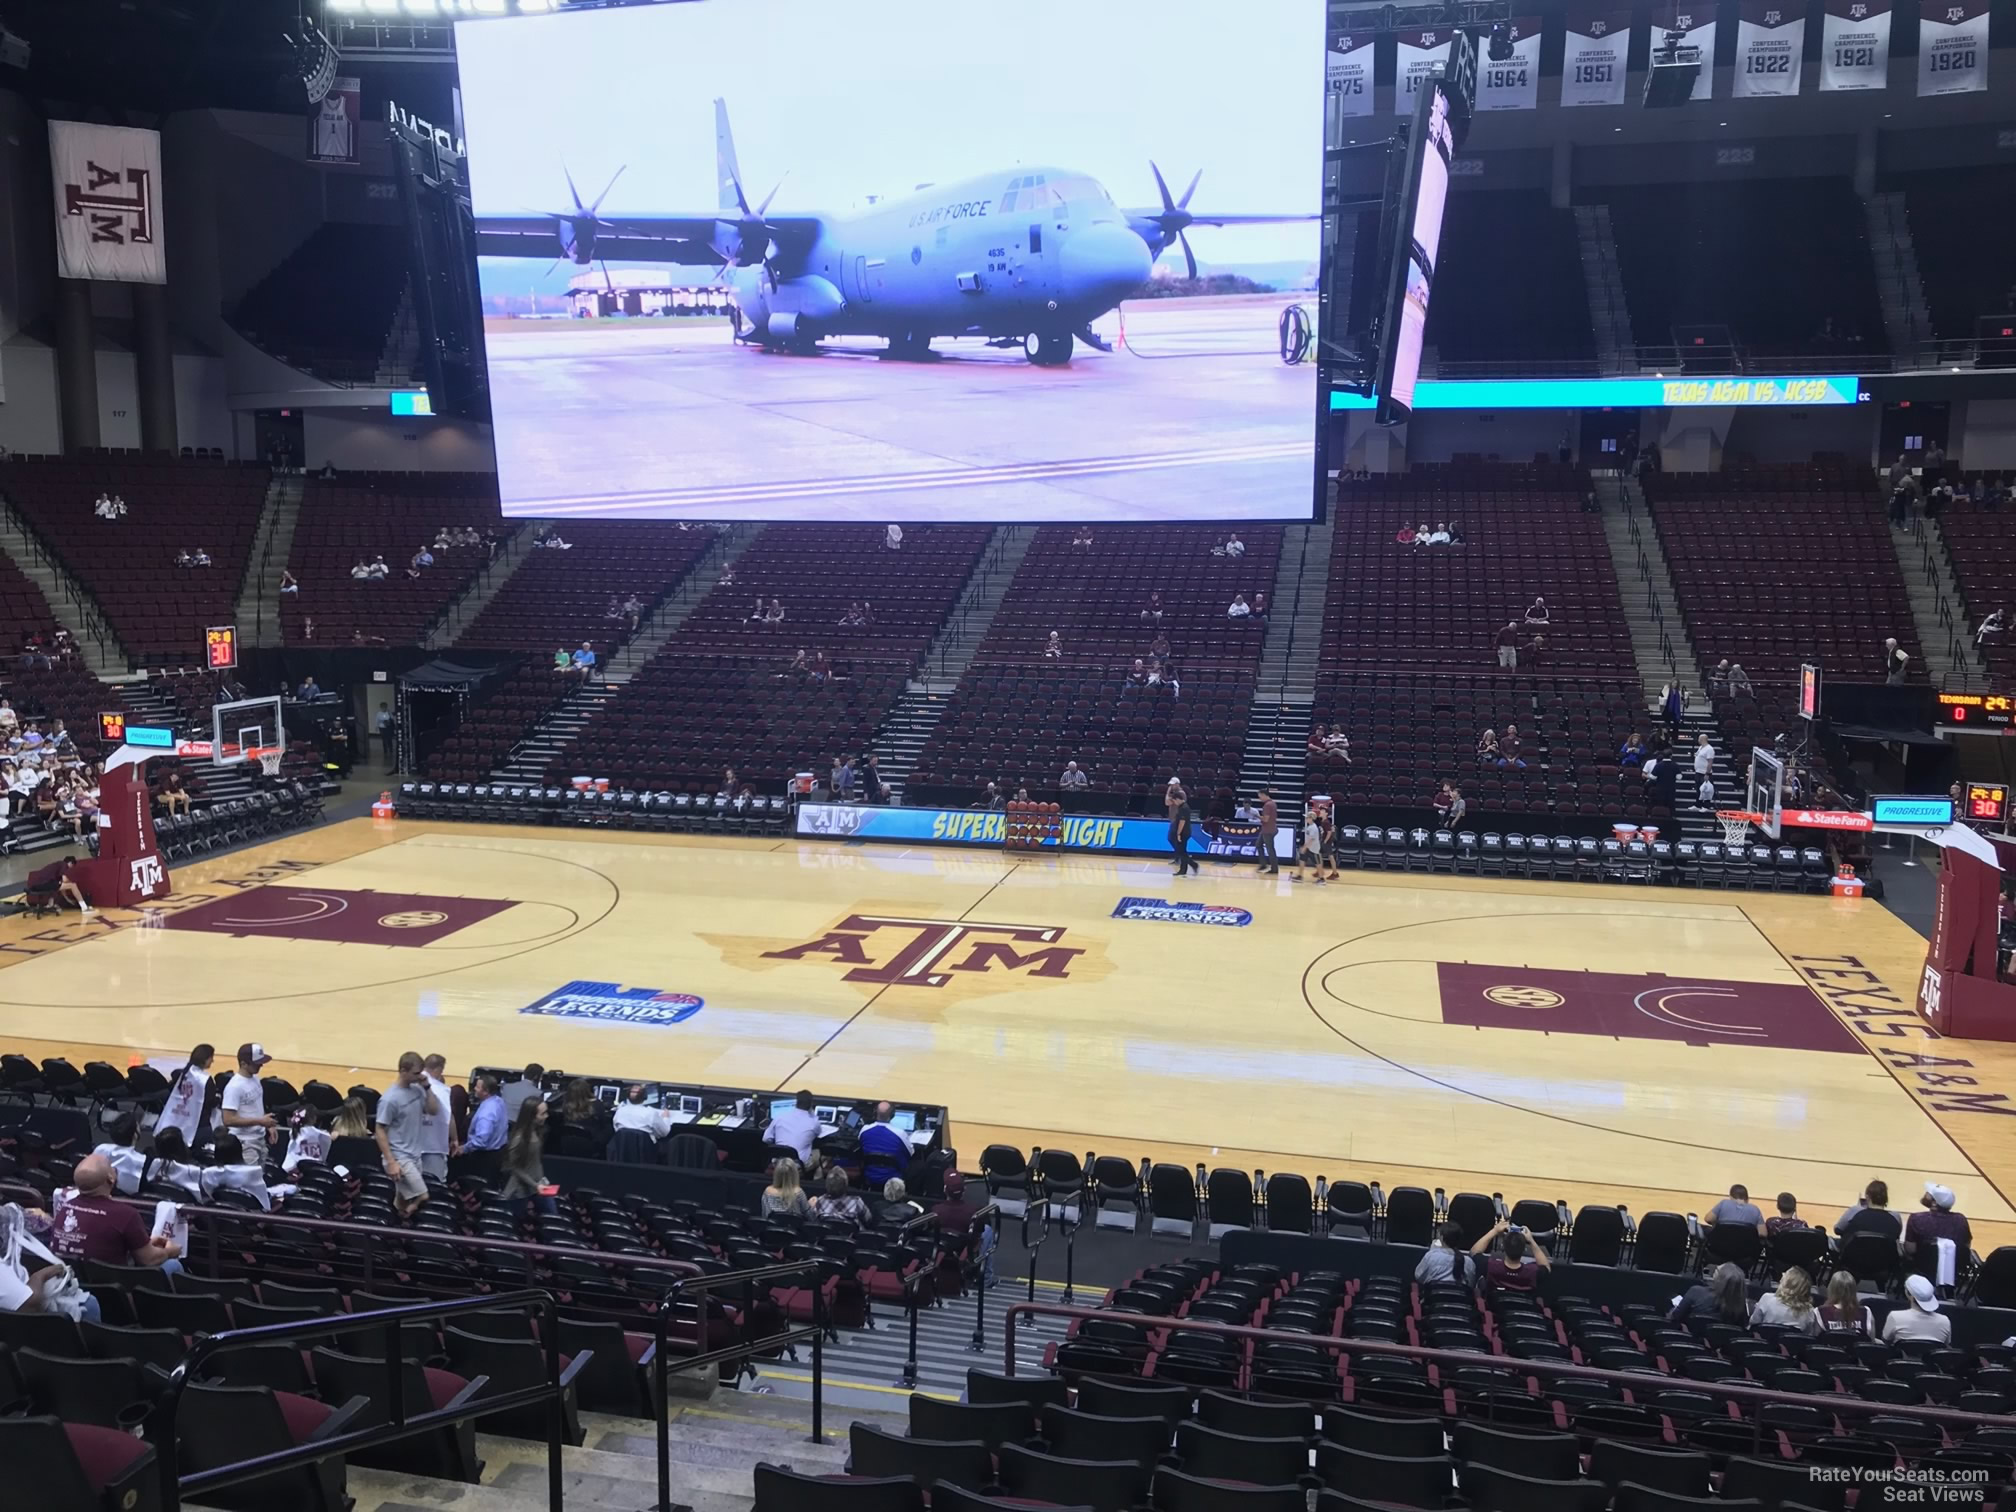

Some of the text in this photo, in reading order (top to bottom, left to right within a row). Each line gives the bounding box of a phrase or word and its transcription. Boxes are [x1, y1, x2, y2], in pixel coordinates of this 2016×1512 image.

[1932, 42, 1977, 50] CHAMPIONSHIP
[1936, 36, 1974, 44] CONFERENCE
[1747, 55, 1790, 73] 1922
[1834, 48, 1874, 66] 1921
[1931, 51, 1976, 71] 1920
[1487, 70, 1527, 88] 1964
[1575, 64, 1613, 83] 1951
[1716, 148, 1754, 164] 223
[1450, 161, 1483, 174] 222
[369, 184, 397, 198] 217
[944, 200, 992, 221] FORCE
[988, 249, 1005, 257] 4635
[988, 264, 995, 272] 19
[1663, 379, 1827, 403] TEXAS A&M VS. UCSB
[212, 644, 229, 664] 30
[1955, 707, 1965, 720] 0
[108, 725, 120, 737] 30
[1971, 788, 2003, 801] 29:18
[1883, 807, 1944, 816] PROGRESSIVE
[1975, 801, 1996, 816] 30
[211, 859, 323, 889] A&M
[1844, 886, 1853, 895] G
[1122, 909, 1238, 923] LEGENDS
[538, 1000, 679, 1019] LEGENDS
[1791, 954, 2016, 1116] TEXAS A&M
